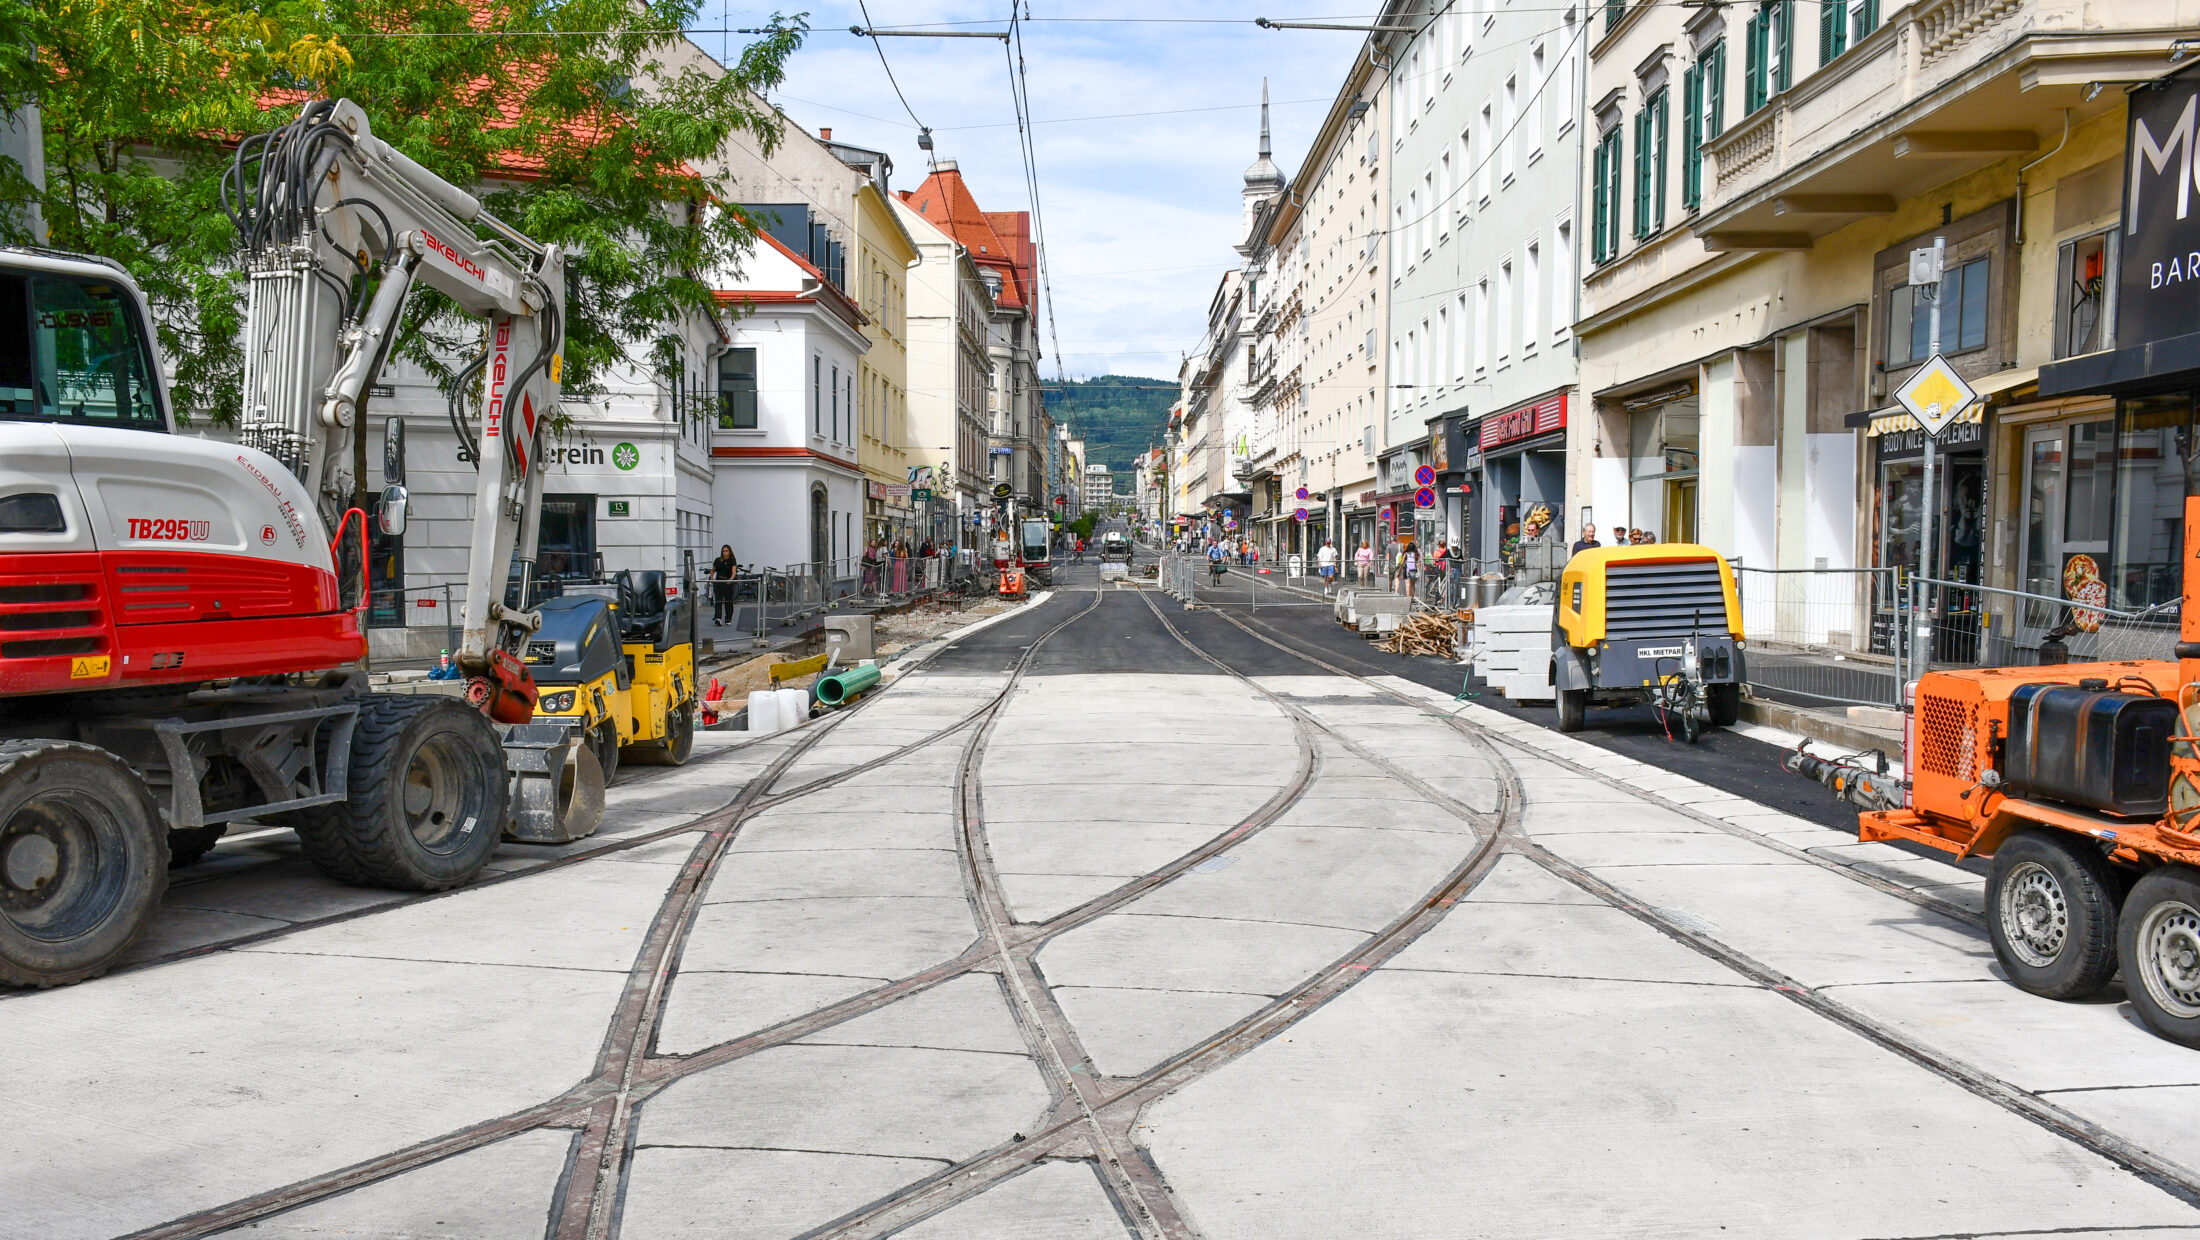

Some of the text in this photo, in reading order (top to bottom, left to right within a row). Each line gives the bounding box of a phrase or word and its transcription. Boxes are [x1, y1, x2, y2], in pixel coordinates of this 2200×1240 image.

[1884, 422, 1981, 453] BODY NICE PPLEMENT
[615, 502, 624, 511] 13
[128, 518, 210, 541] TB295W
[1653, 648, 1681, 656] MIETPAR
